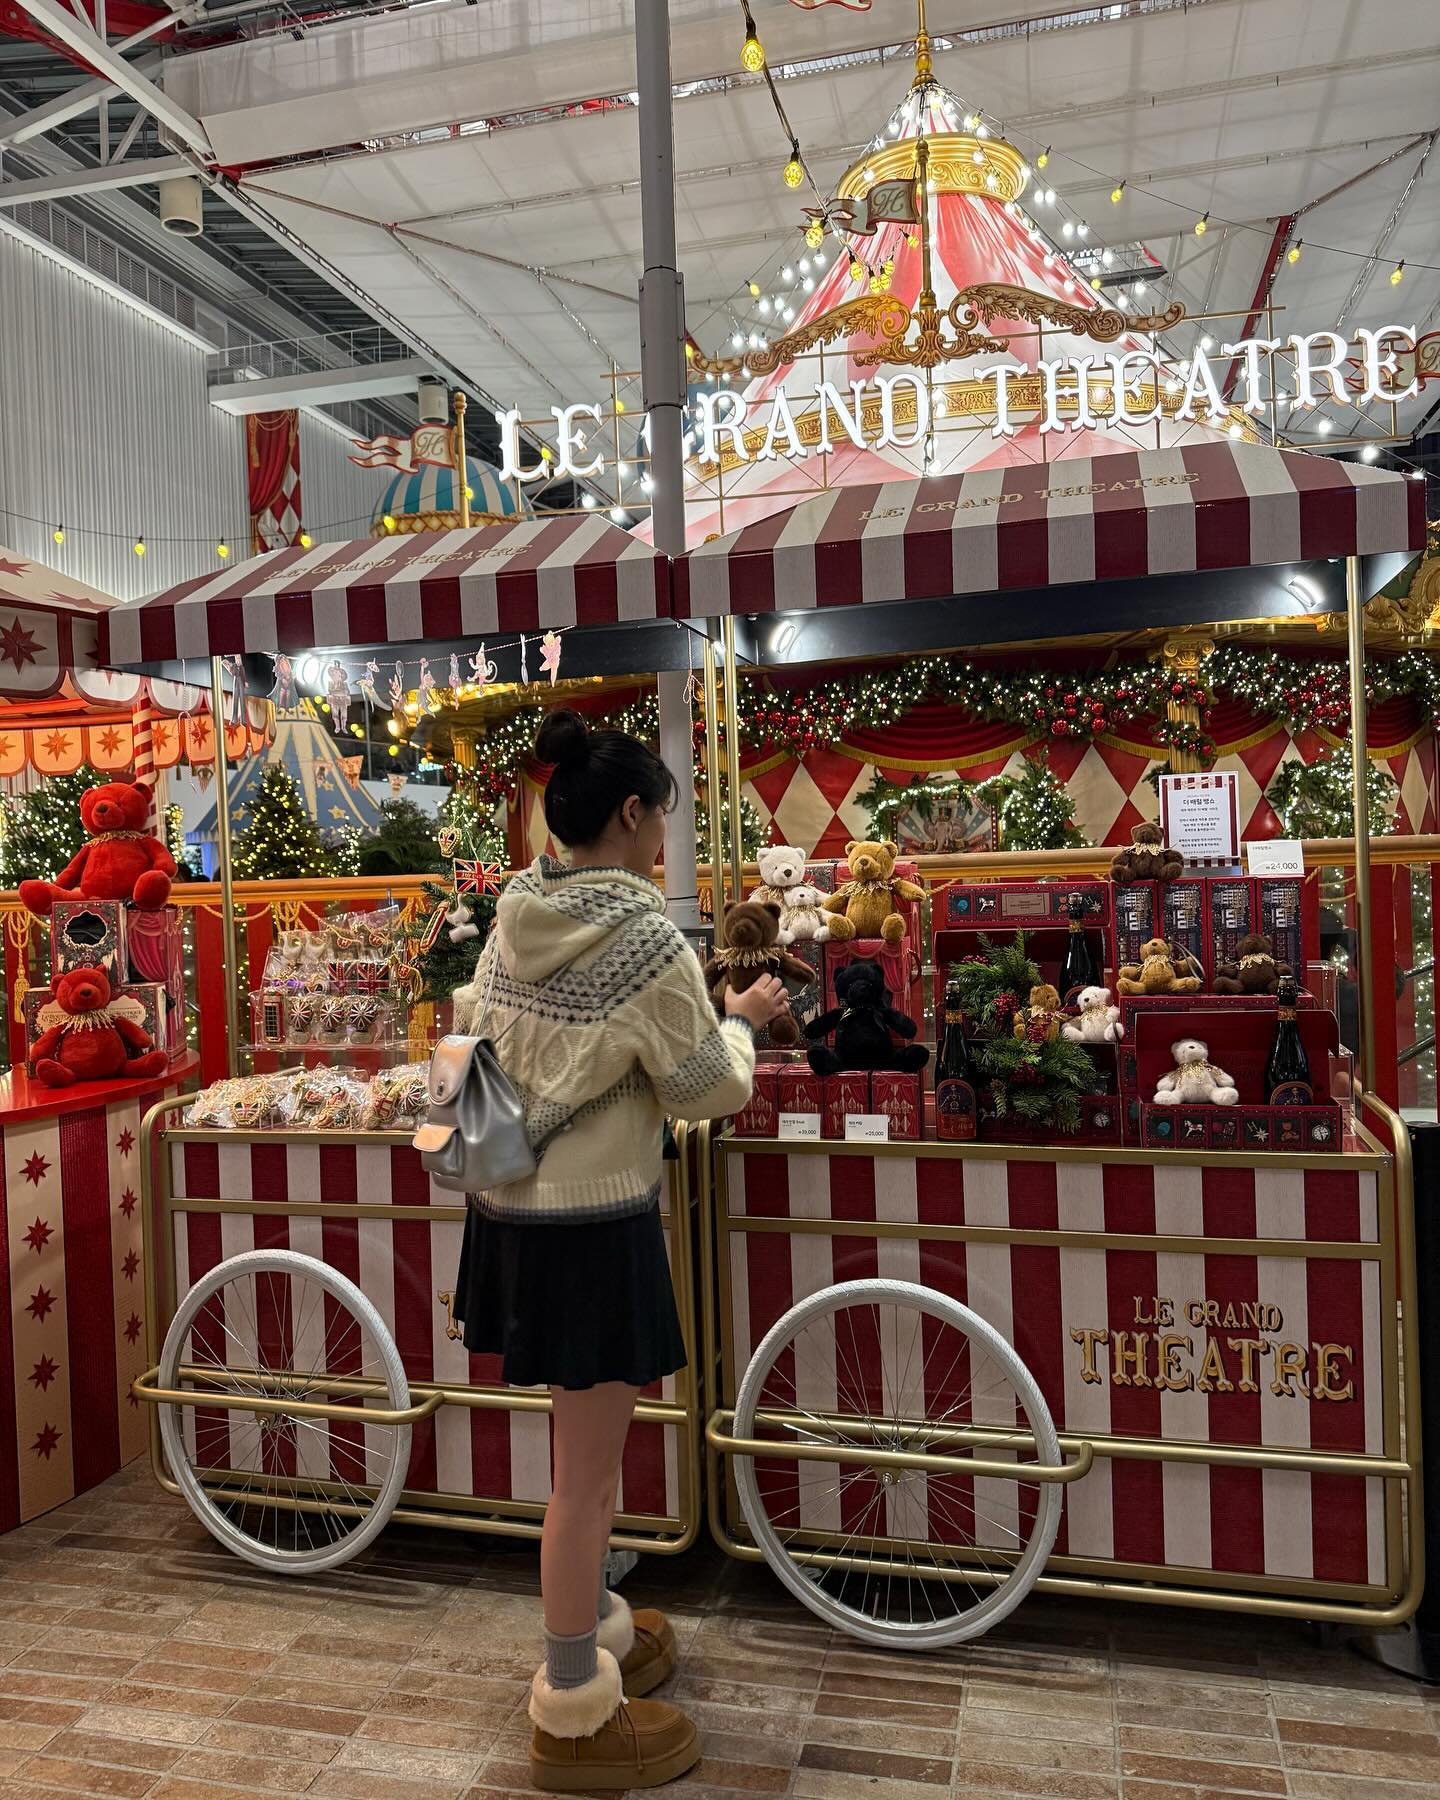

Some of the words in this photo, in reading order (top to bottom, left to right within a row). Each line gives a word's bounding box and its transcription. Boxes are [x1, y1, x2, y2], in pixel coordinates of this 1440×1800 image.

[495, 402, 604, 483] LE
[973, 324, 1419, 440] THEATRE
[858, 506, 905, 521] LE
[915, 492, 1024, 514] GRAND
[1034, 472, 1201, 500] THEATRE
[264, 567, 308, 581] LE
[311, 559, 397, 575] GRAND
[404, 544, 534, 565] THEATRE
[1133, 1295, 1175, 1327] LE
[1183, 1297, 1284, 1332] GRAND
[1069, 1326, 1355, 1402] THEATRE
